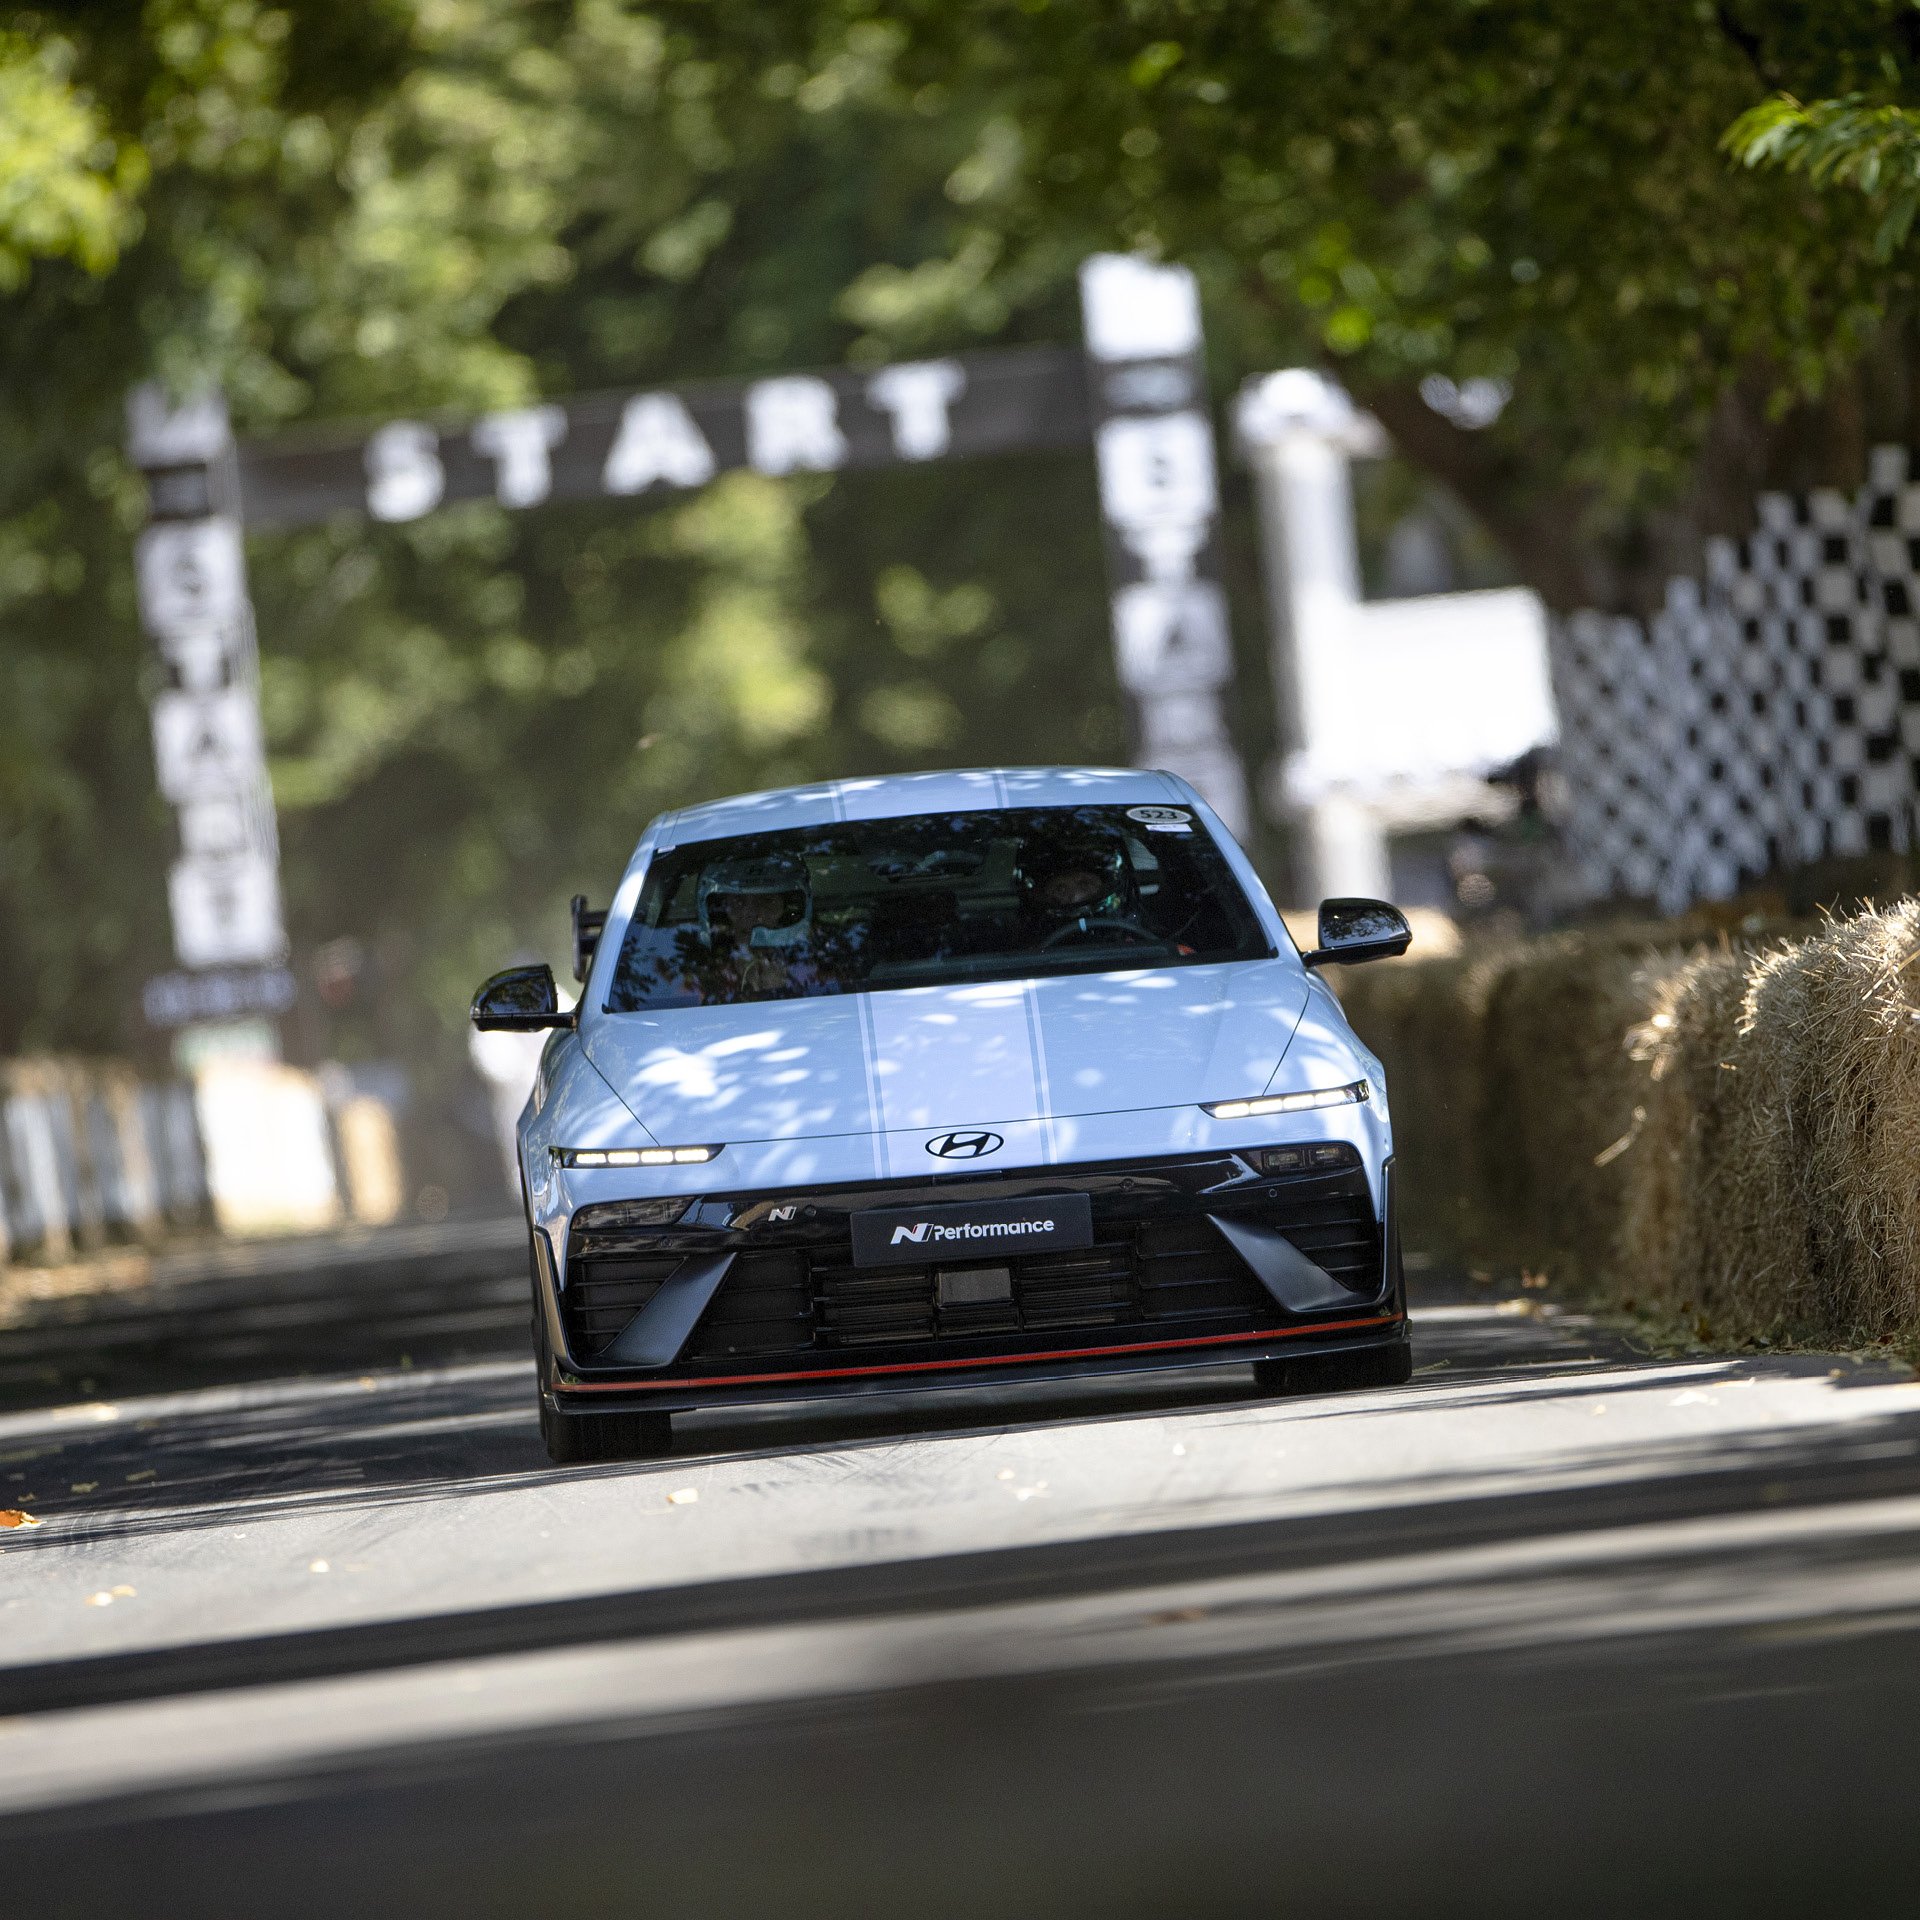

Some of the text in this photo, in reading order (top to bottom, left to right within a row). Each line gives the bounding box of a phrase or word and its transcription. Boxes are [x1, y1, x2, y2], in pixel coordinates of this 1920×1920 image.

[364, 359, 966, 522] START
[1140, 810, 1178, 819] 523
[934, 1220, 1055, 1241] Performance
